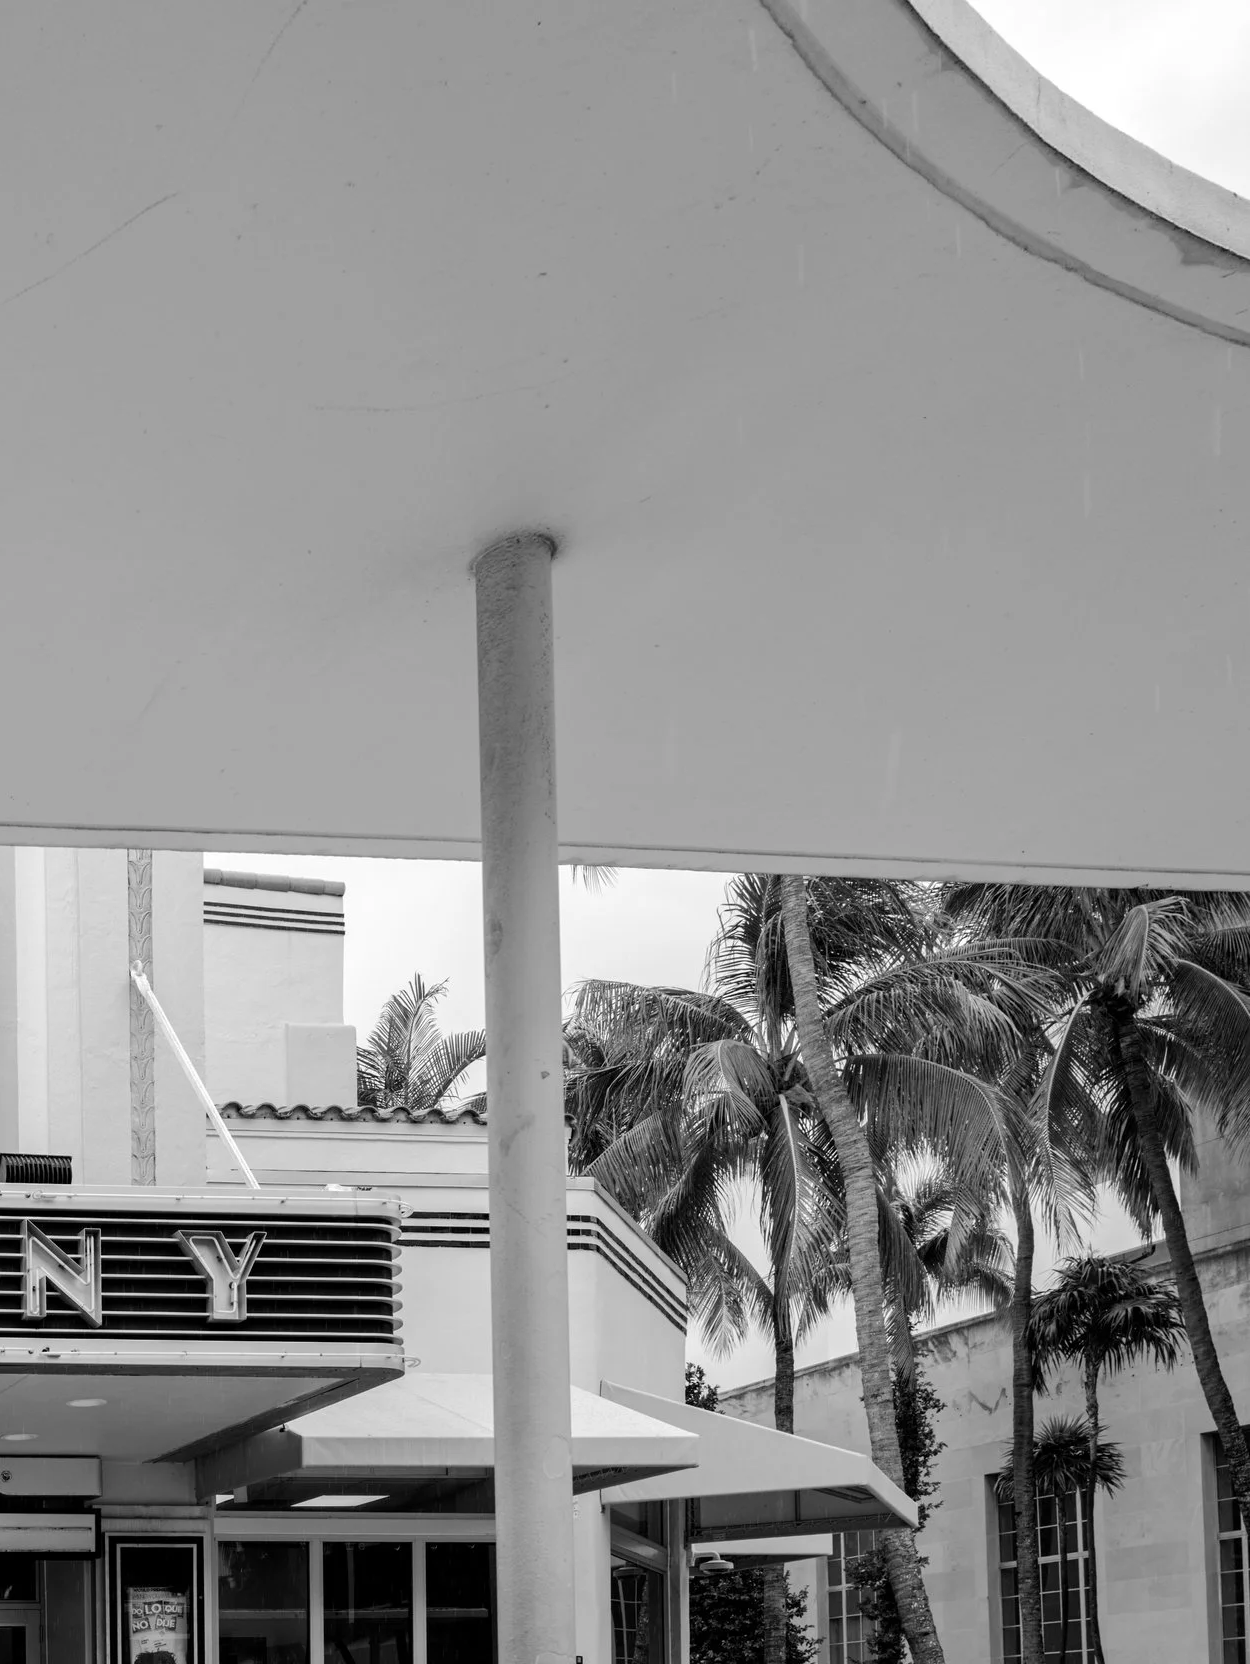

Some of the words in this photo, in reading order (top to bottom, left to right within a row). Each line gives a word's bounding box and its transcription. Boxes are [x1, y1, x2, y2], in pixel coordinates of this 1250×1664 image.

[144, 1603, 162, 1615] LO
[164, 1604, 183, 1613] QUE
[132, 1620, 149, 1631] NO
